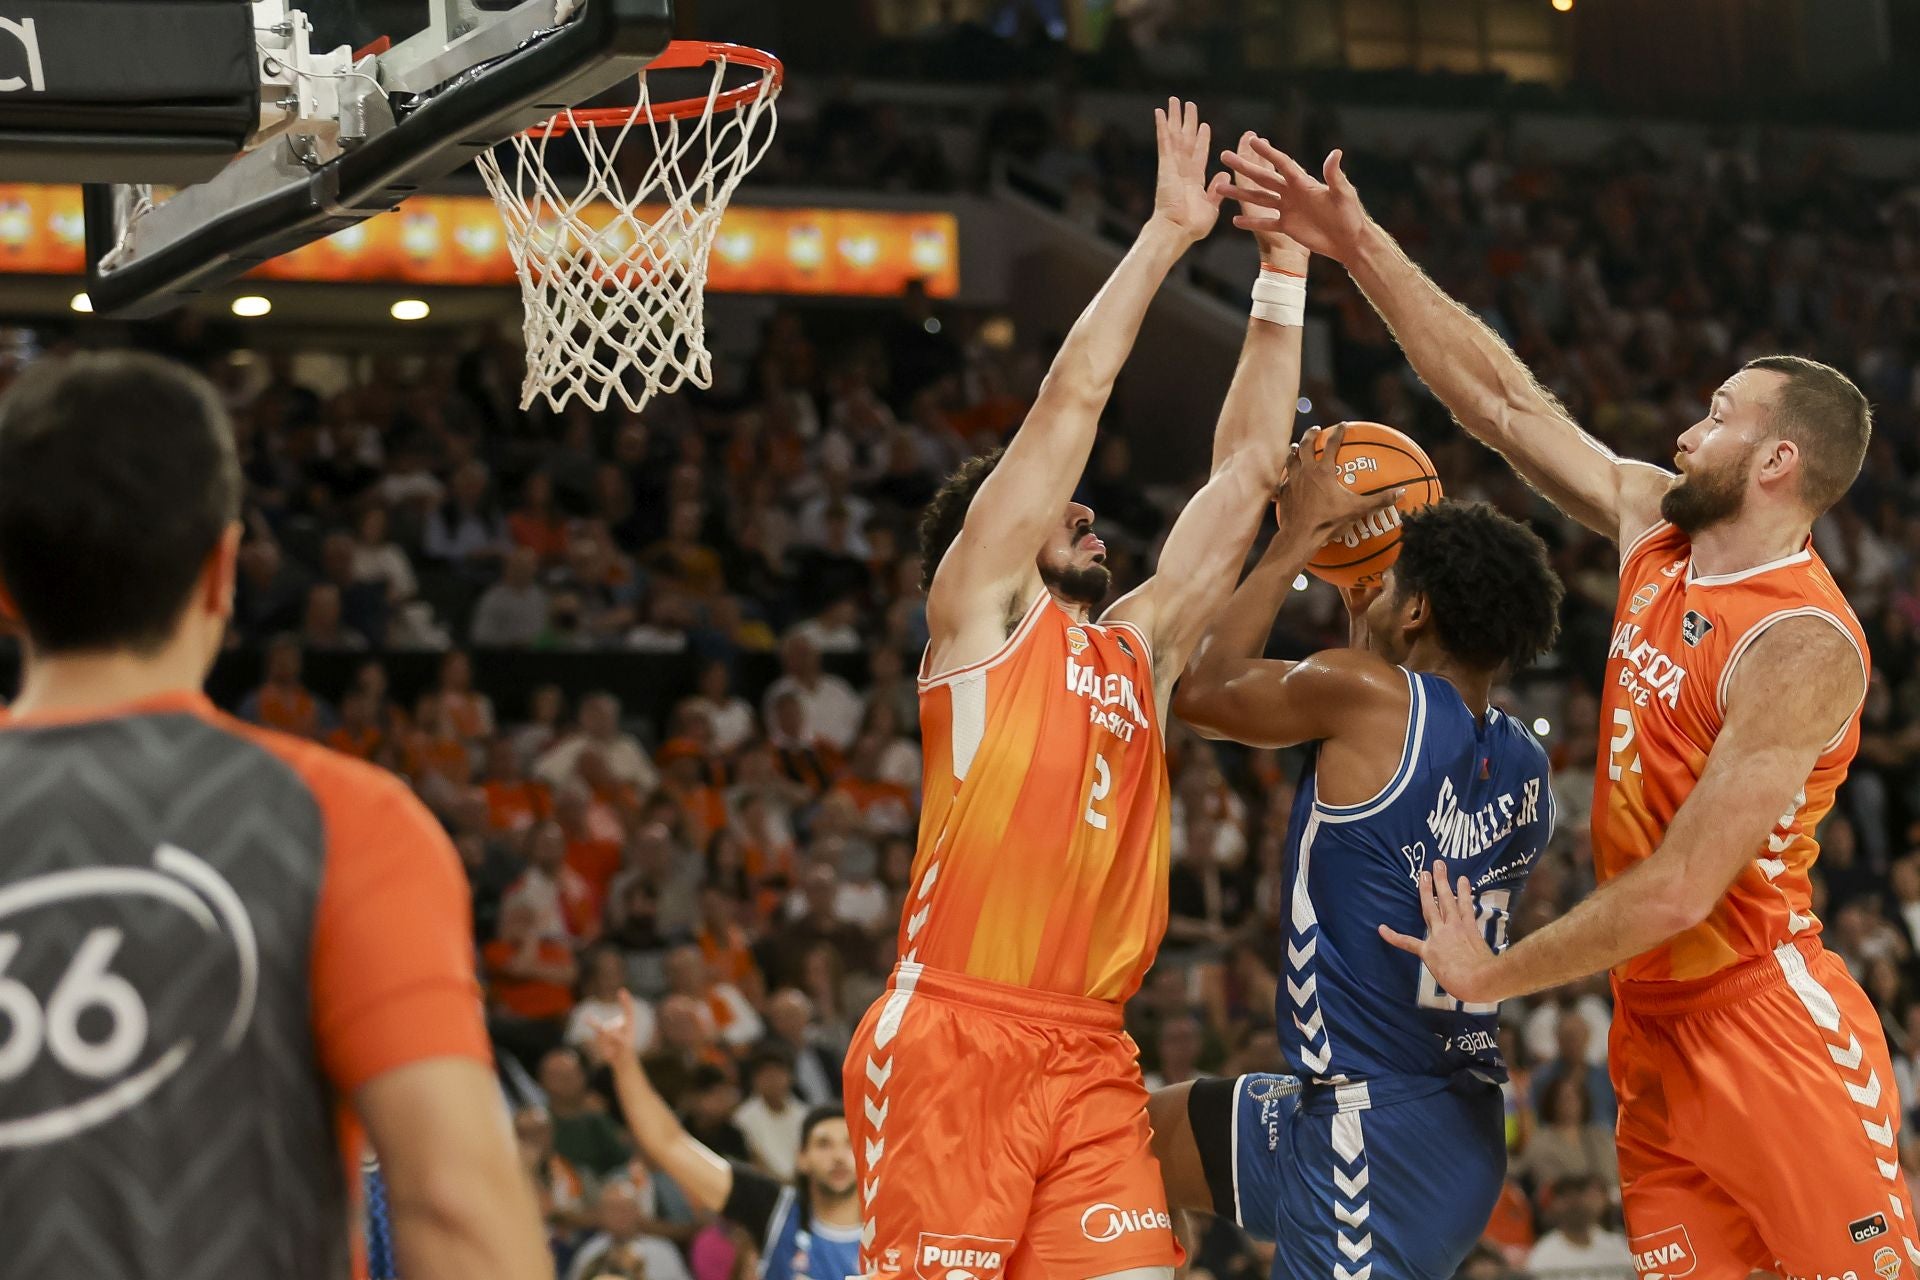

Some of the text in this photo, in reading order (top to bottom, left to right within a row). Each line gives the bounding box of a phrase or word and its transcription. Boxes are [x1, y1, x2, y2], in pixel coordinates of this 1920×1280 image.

[1344, 457, 1377, 473] liga
[1084, 753, 1111, 830] 2
[1516, 777, 1540, 827] JR
[1854, 1225, 1880, 1241] acb
[923, 1245, 1001, 1270] PULEVA
[1633, 1242, 1687, 1272] ULEVA
